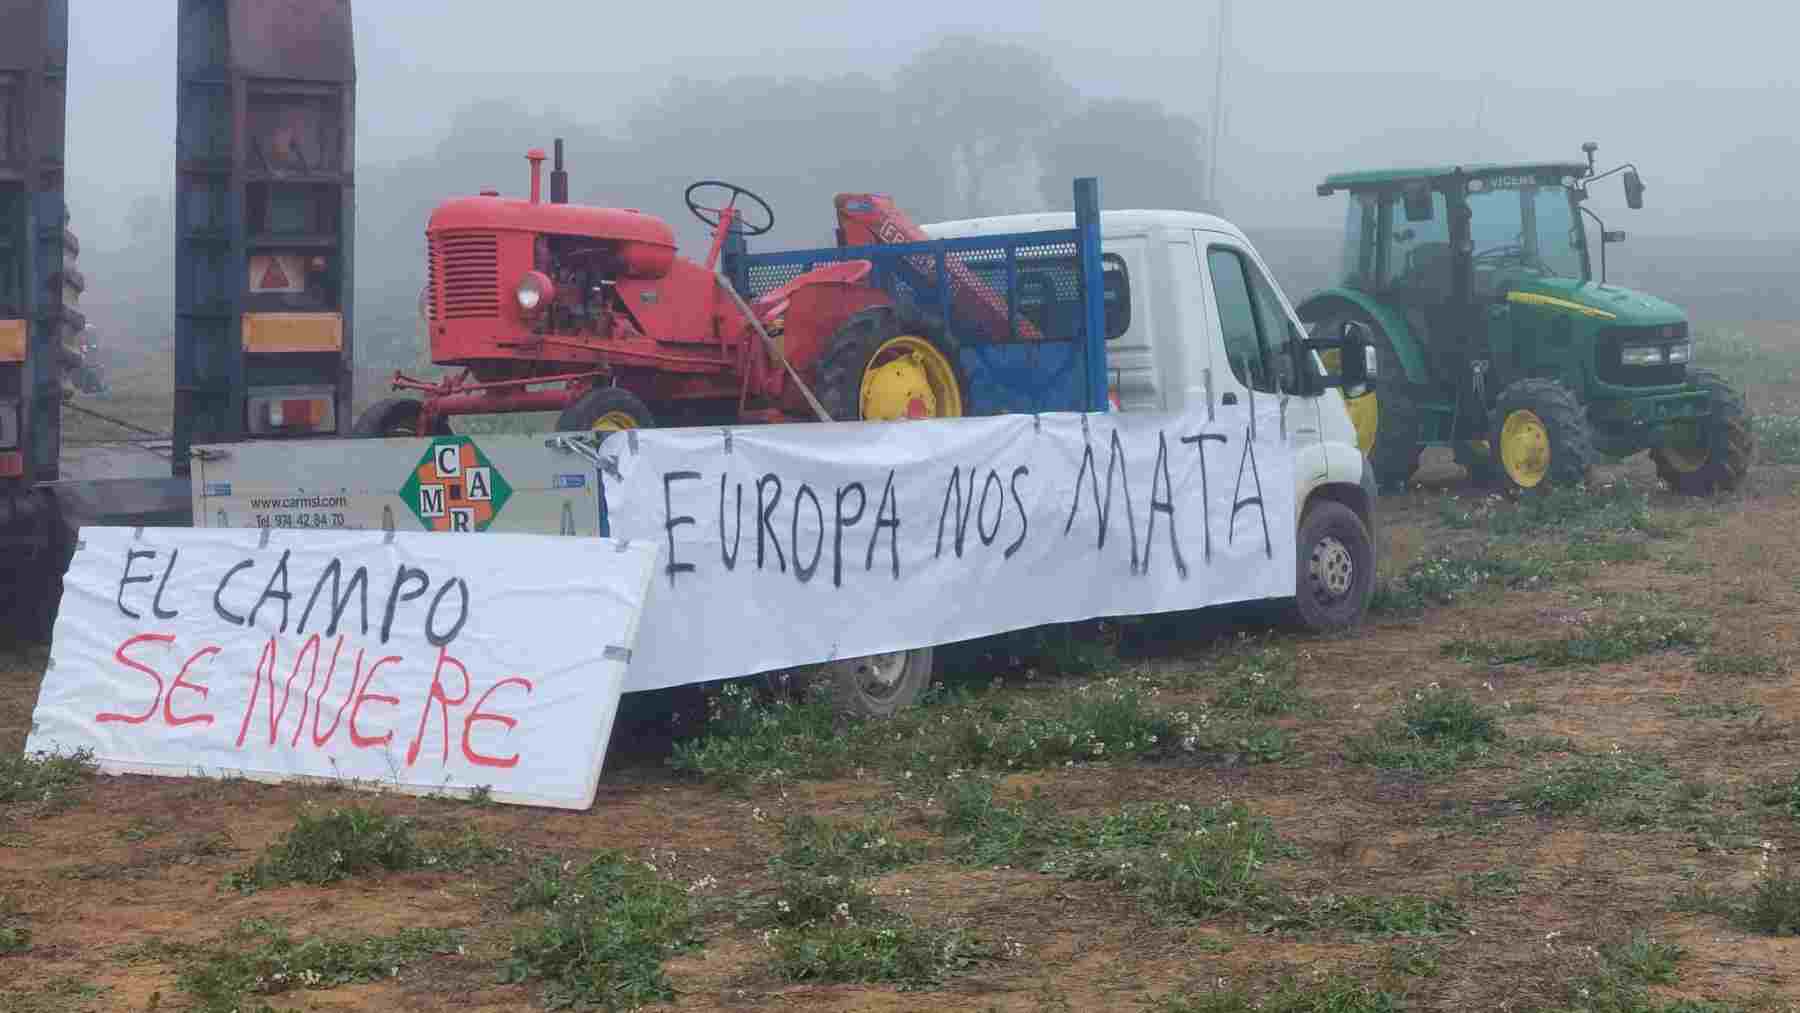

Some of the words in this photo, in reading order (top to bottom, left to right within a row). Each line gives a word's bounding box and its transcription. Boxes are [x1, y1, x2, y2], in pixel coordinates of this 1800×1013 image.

[662, 470, 901, 589] EUROPA
[934, 465, 1030, 560] NOS
[1064, 427, 1272, 580] MATA
[116, 548, 179, 620] EL
[212, 548, 469, 647] CAMPO
[95, 632, 222, 728] SE
[235, 632, 534, 769] MUERE
